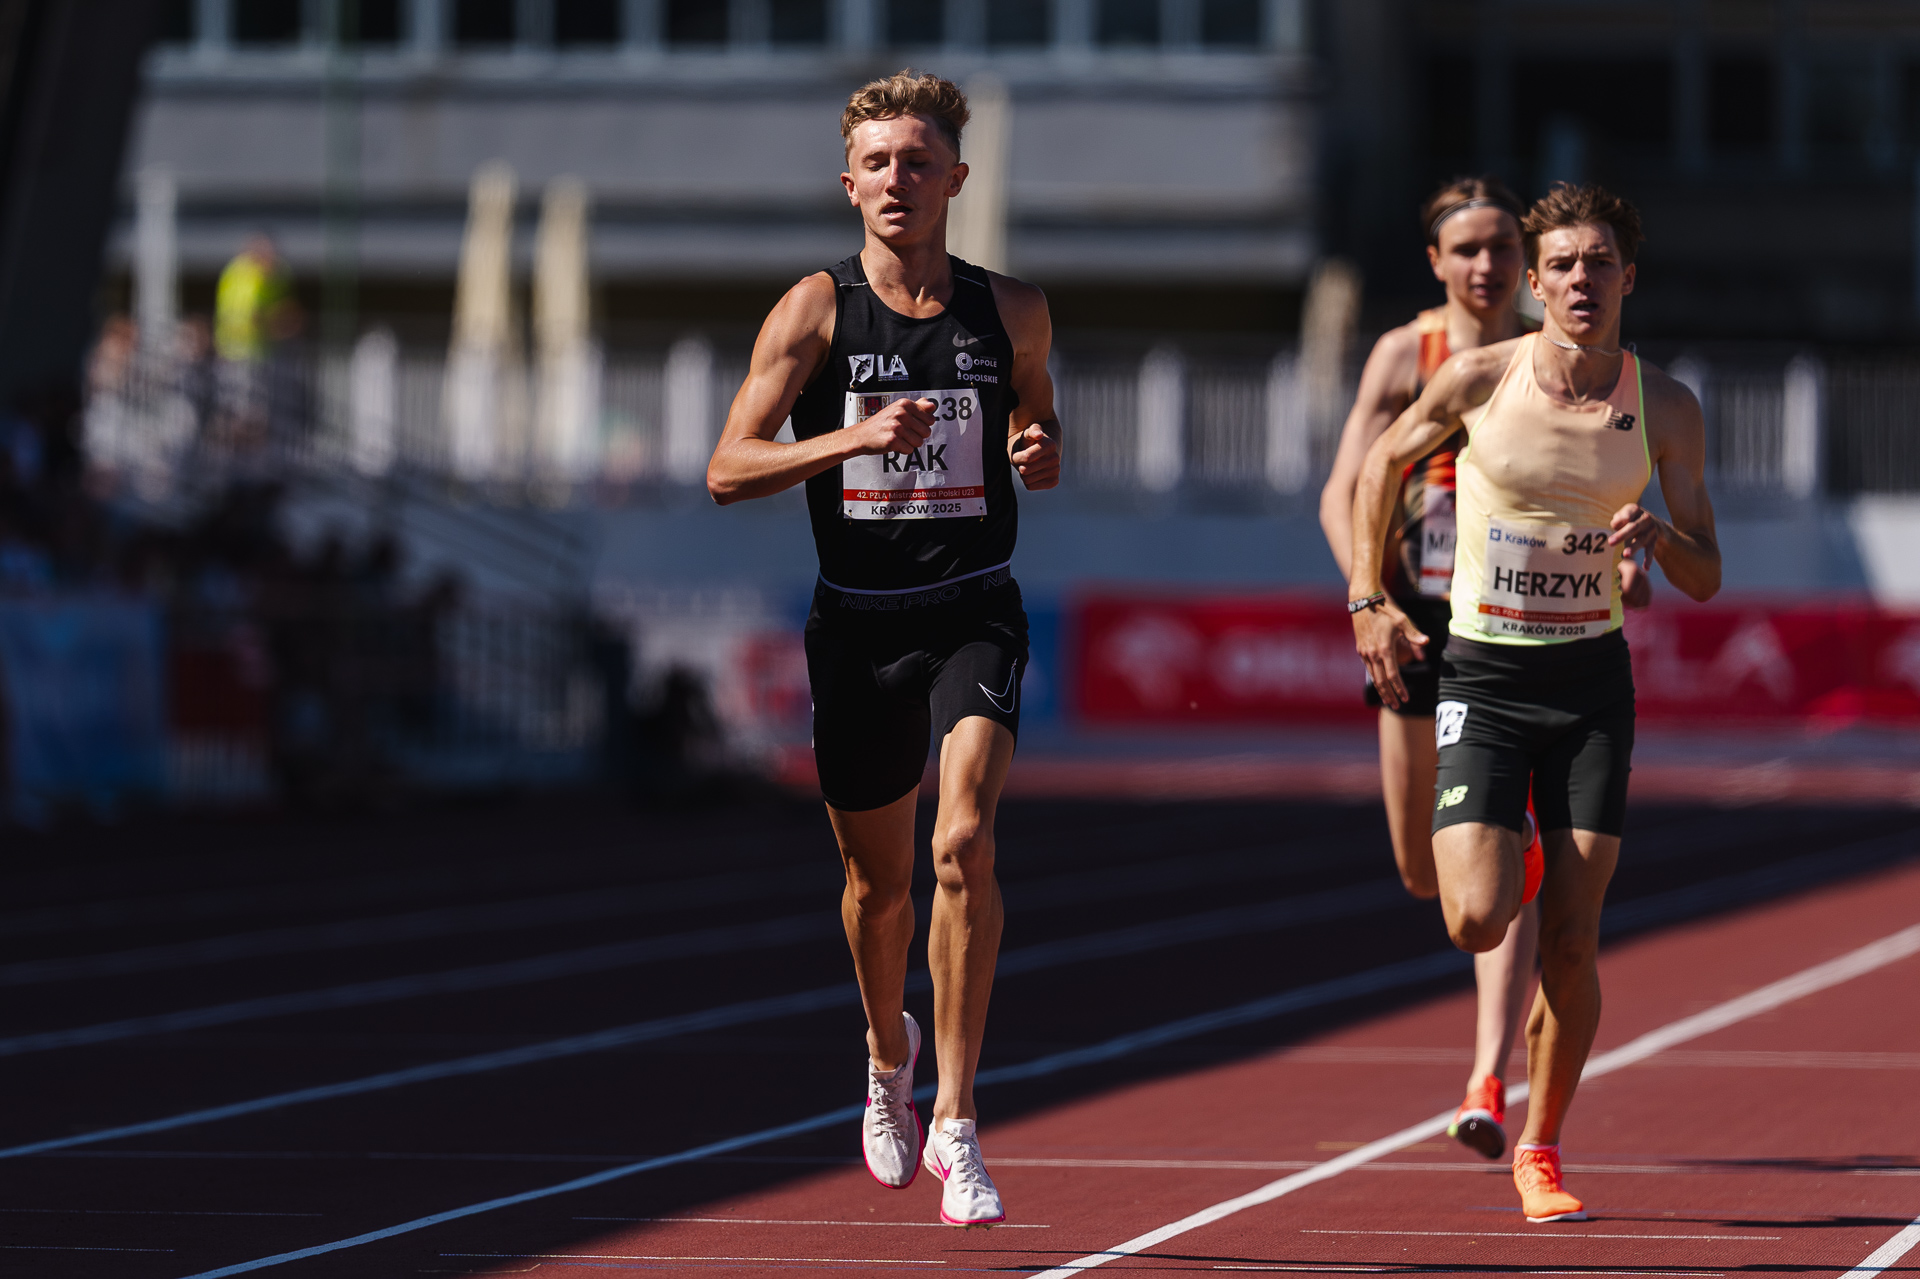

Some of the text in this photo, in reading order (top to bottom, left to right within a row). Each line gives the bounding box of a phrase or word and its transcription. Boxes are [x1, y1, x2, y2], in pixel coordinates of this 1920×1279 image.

[876, 354, 909, 377] LA
[973, 357, 998, 369] OPOLE
[962, 373, 998, 384] OPOLSKIE
[882, 444, 949, 473] RAK
[869, 491, 888, 500] PZLA
[888, 489, 937, 499] Mistrzostwa
[938, 488, 961, 497] Polski
[961, 487, 975, 496] U23
[871, 502, 962, 515] KRAKÓW 2025
[1505, 533, 1547, 548] Kraków
[1562, 532, 1608, 555] 342
[1493, 566, 1603, 599] HERZYK
[840, 585, 961, 611] NIKE PRO
[1502, 622, 1586, 636] KRAKÓW 2025
